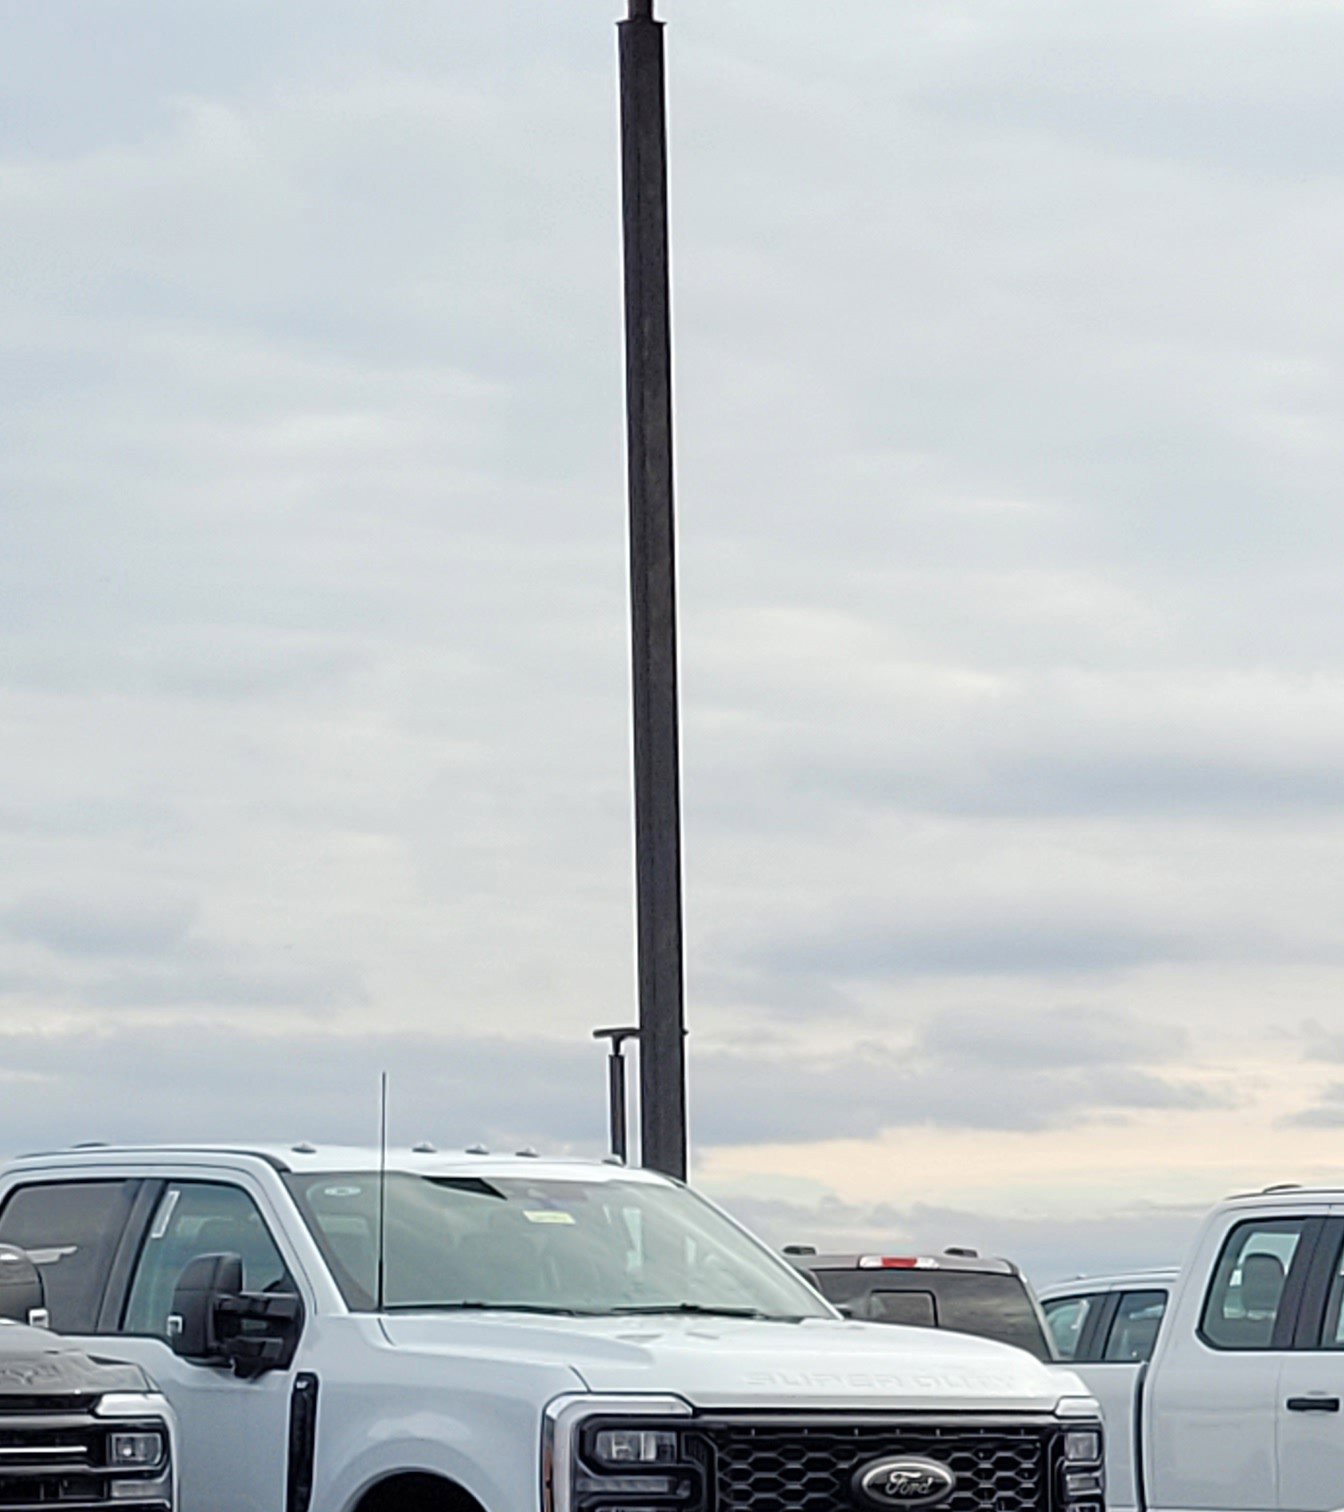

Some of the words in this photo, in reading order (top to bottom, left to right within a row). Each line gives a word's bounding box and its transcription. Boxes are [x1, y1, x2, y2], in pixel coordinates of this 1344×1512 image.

[746, 1371, 904, 1388] SUPER
[913, 1374, 1016, 1390] DUTY
[884, 1470, 935, 1496] Ford
